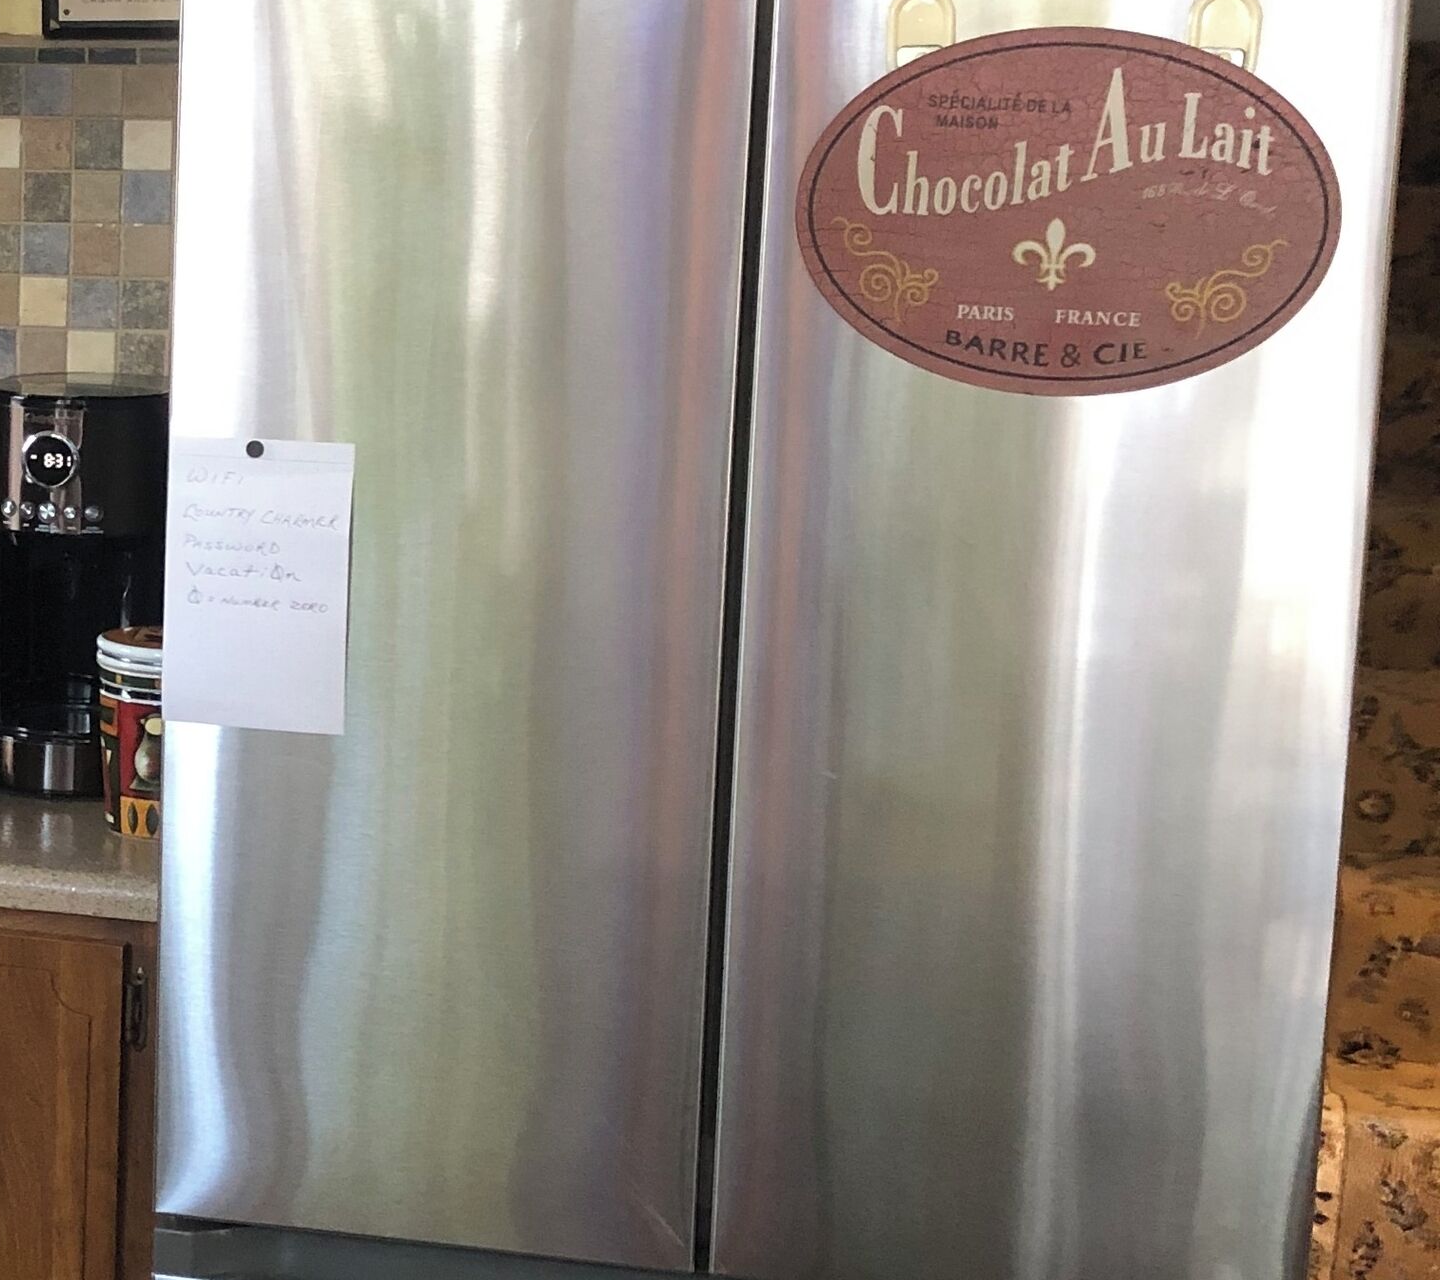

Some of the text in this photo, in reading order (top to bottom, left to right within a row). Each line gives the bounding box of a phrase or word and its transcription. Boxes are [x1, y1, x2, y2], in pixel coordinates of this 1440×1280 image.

[1027, 99, 1046, 113] DE
[1052, 101, 1072, 114] LA
[936, 115, 999, 129] MAISON
[857, 67, 1274, 216] Chocolat Au Lait
[957, 304, 1141, 327] PARIS FRANCE
[946, 330, 1147, 368] BARRE & CIE
